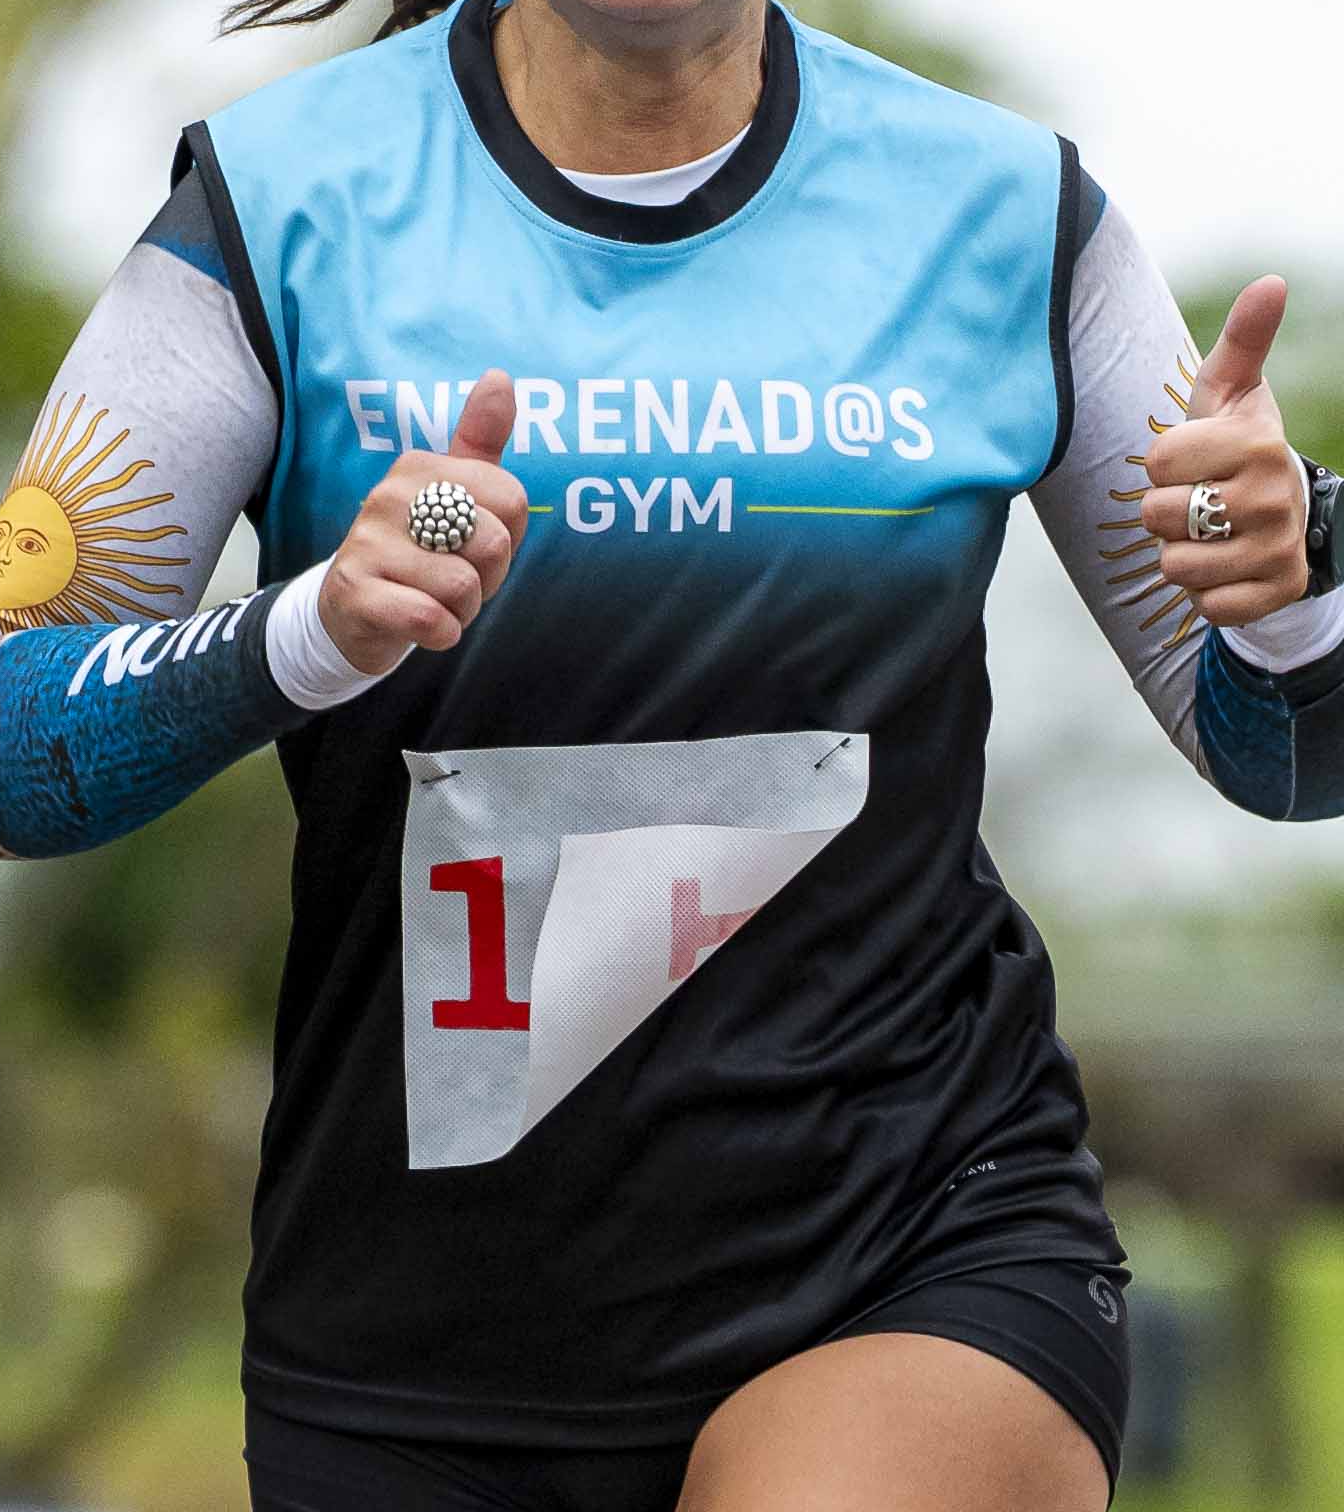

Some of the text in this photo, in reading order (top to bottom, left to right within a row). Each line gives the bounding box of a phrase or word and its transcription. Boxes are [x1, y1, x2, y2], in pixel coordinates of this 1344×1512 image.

[345, 377, 935, 461] ENRENAD@S
[565, 476, 734, 534] GYM
[429, 856, 531, 1031] 1
